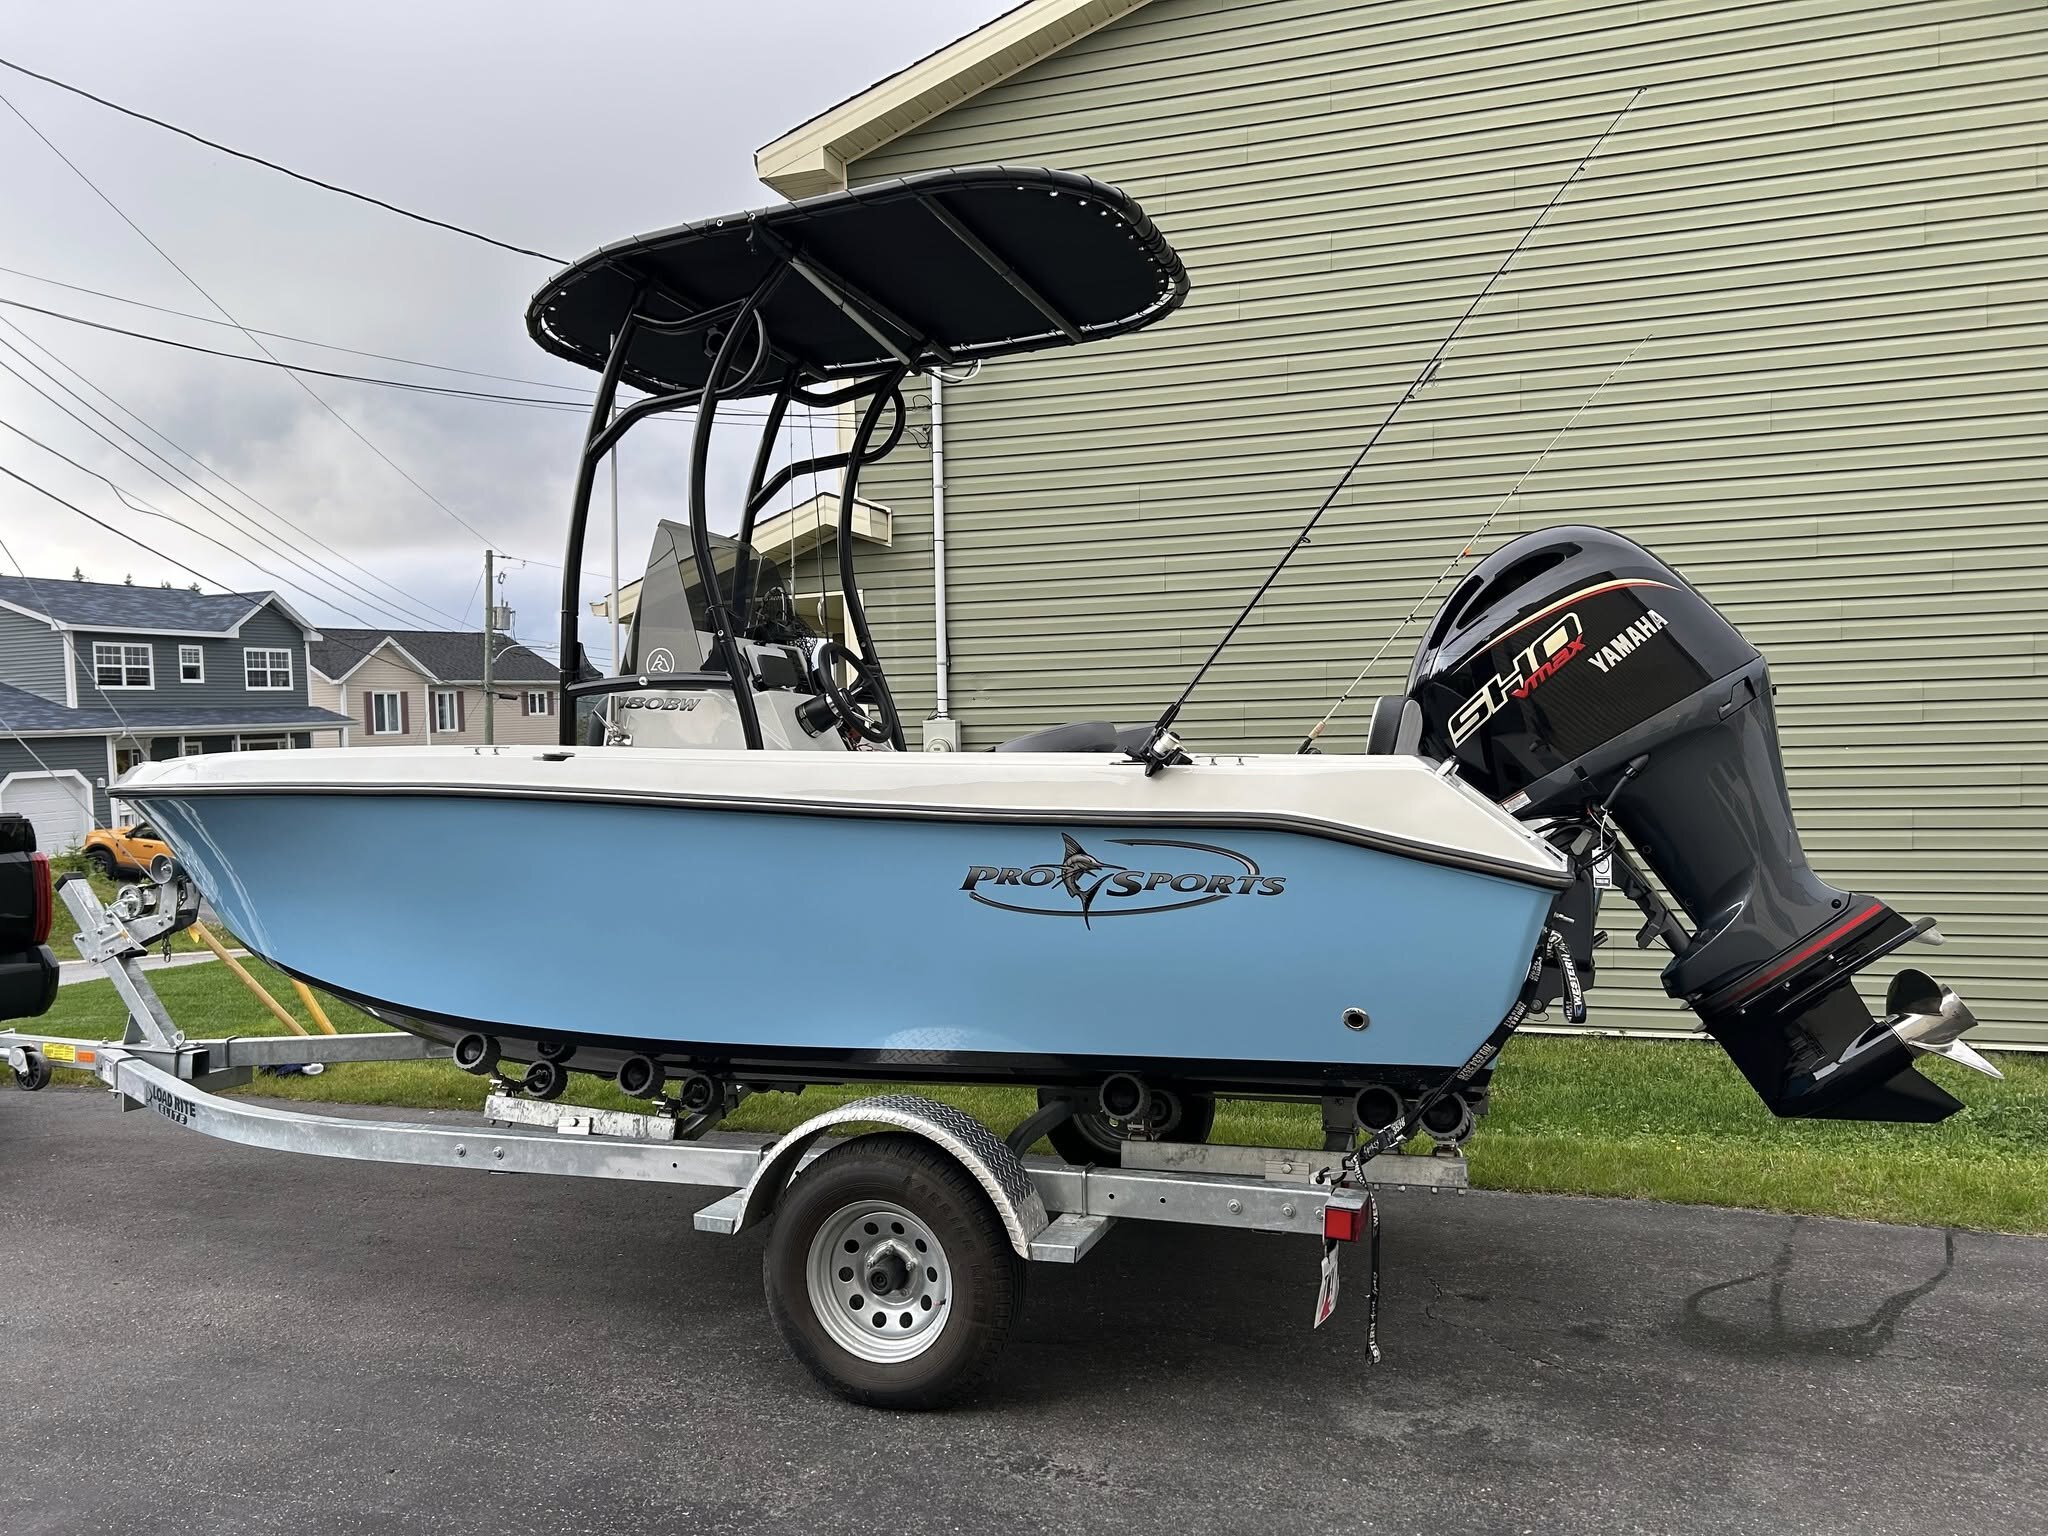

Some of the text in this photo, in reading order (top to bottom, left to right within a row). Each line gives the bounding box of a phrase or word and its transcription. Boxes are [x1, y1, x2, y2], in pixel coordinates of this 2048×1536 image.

[1587, 609, 1669, 673] YAMAHA
[1448, 612, 1583, 748] SHO
[959, 866, 1287, 896] PRO SPORTS
[1562, 953, 1582, 1006] WESTERN
[153, 1085, 196, 1117] LOAD RITE
[160, 1104, 185, 1123] ELITE
